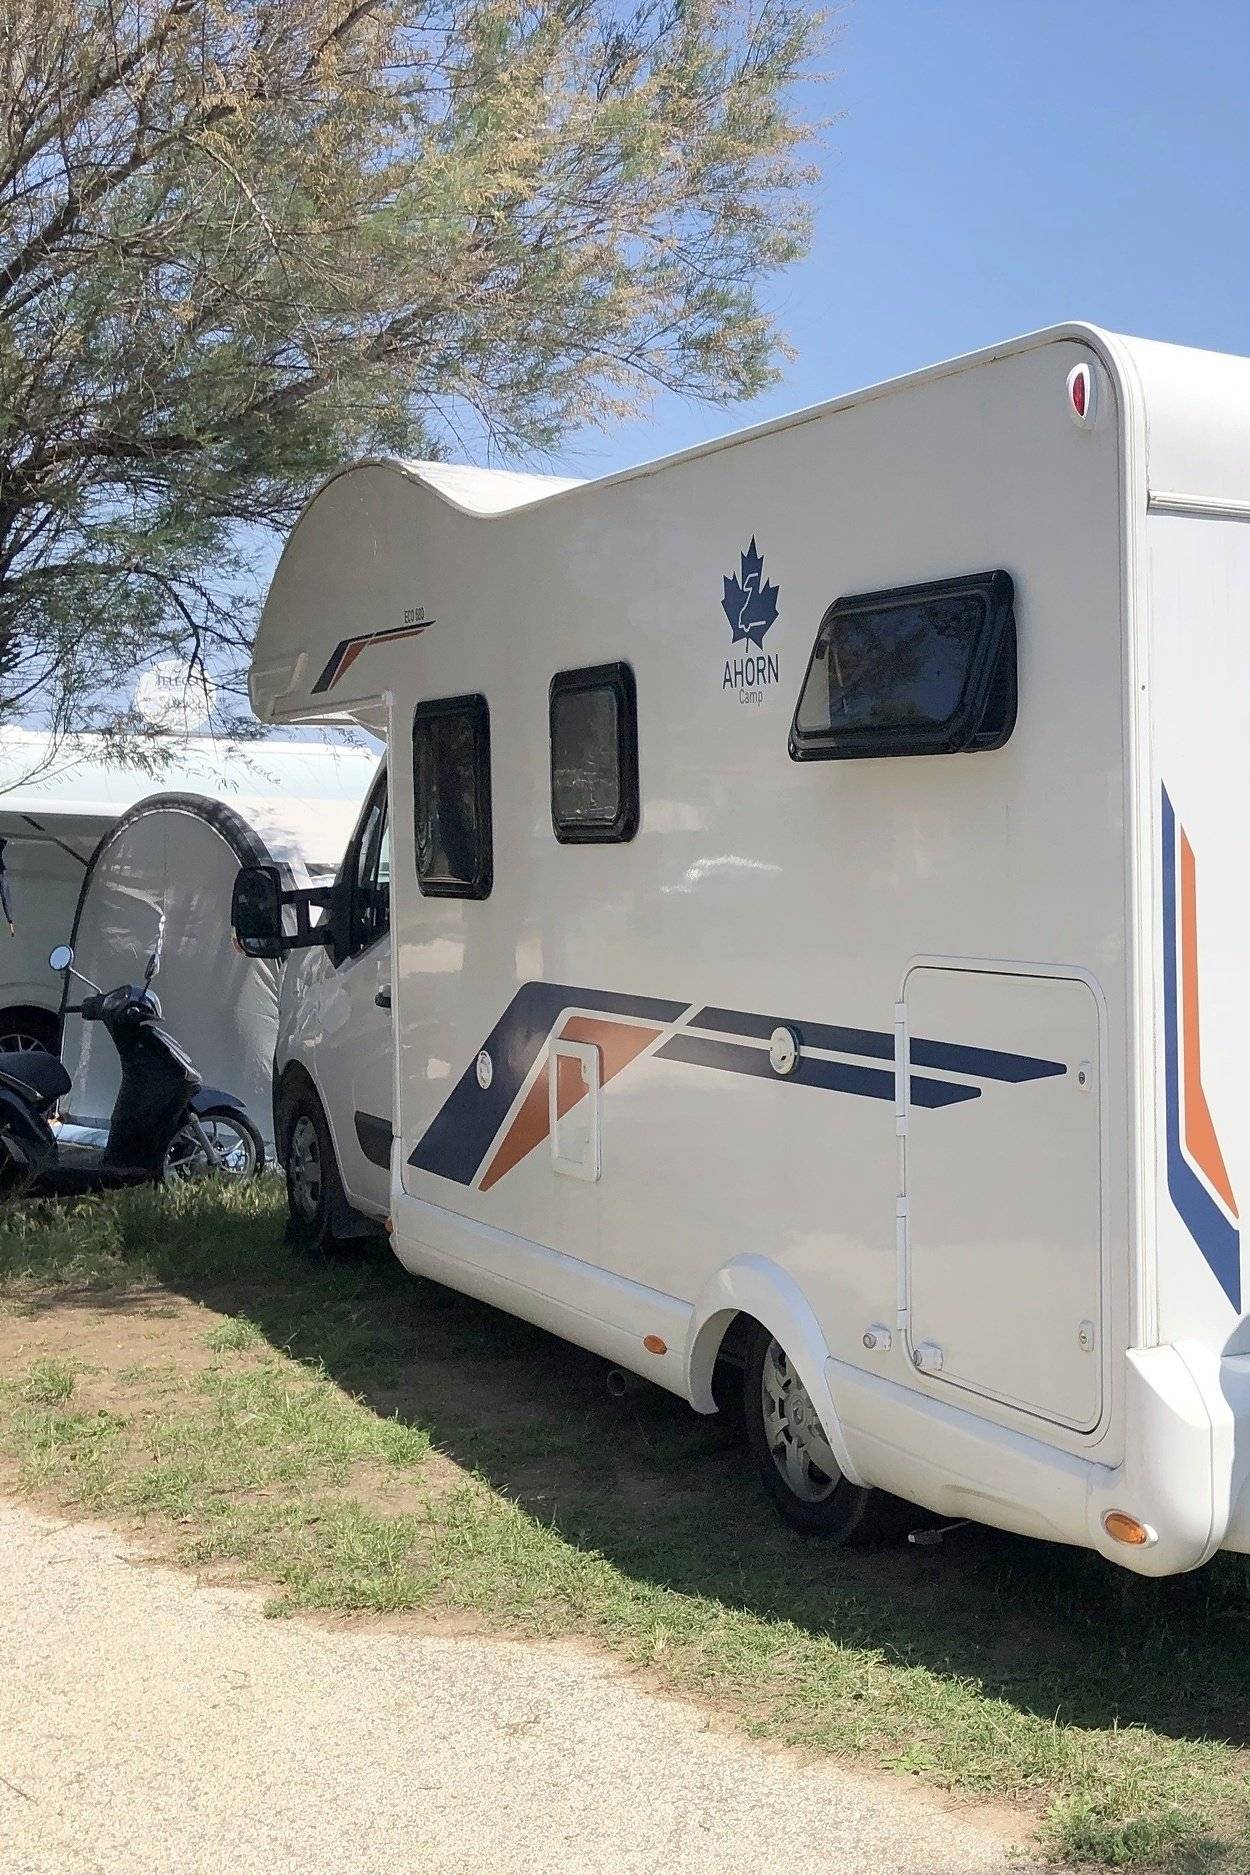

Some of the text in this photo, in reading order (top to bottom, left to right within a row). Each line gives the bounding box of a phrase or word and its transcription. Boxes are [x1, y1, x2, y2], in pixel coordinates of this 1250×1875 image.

[404, 609, 414, 623] ECO
[722, 653, 779, 689] AHORN
[739, 688, 763, 706] Camp
